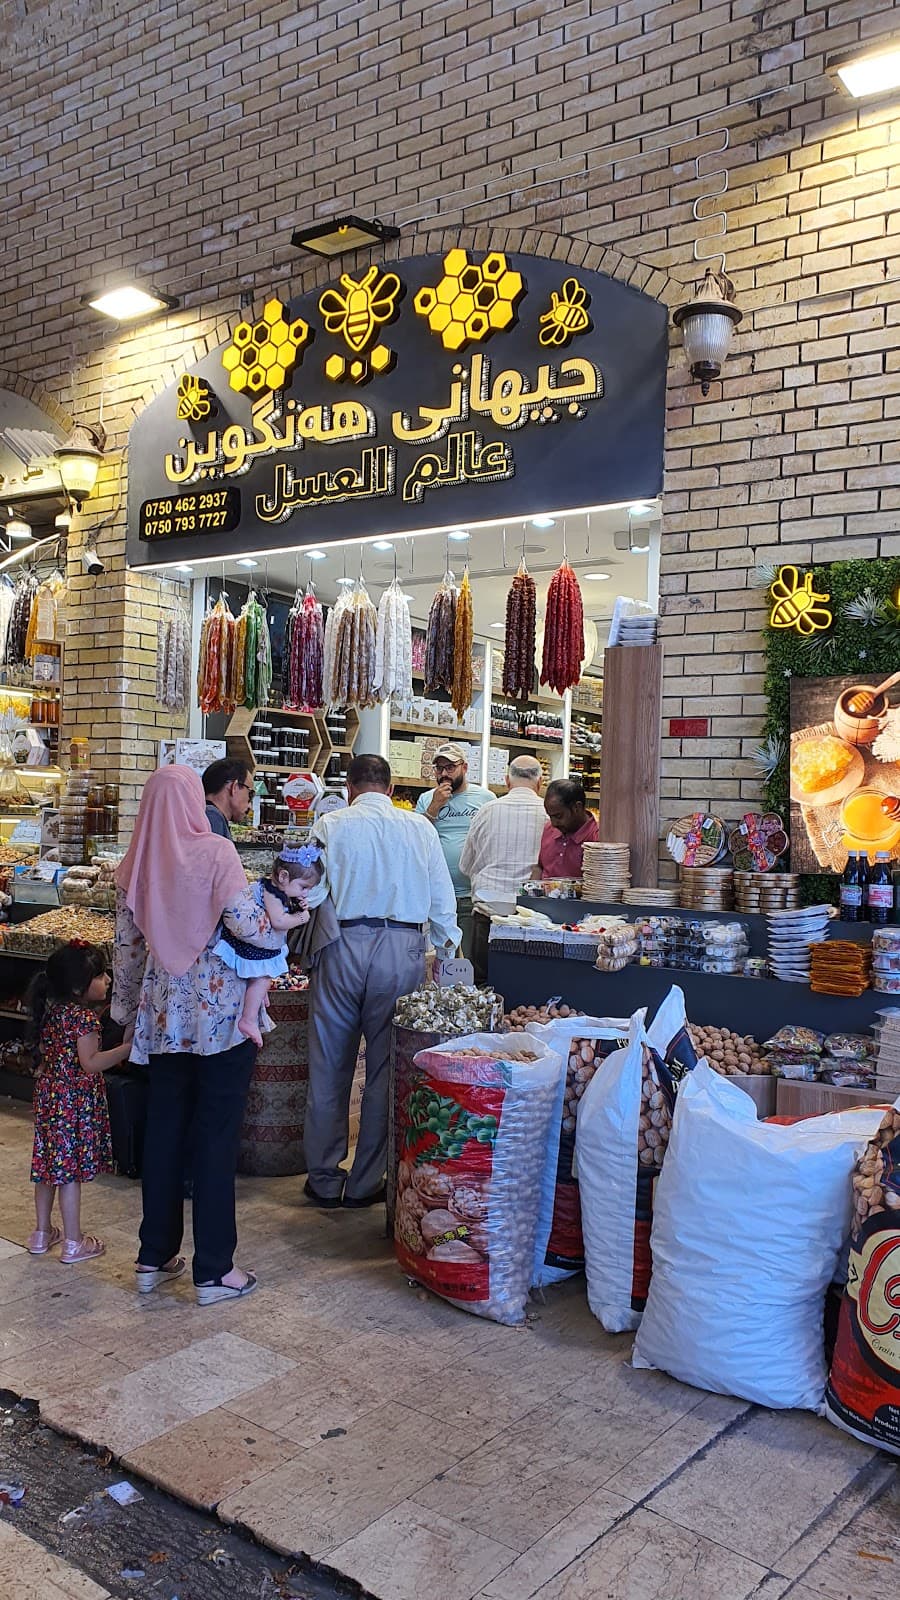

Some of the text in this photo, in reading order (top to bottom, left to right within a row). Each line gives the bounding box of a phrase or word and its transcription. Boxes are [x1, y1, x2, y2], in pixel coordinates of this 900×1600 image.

[255, 431, 508, 521] عالم العسل
[145, 491, 228, 517] 0750 462 2937
[144, 511, 228, 536] 0750 793 7727
